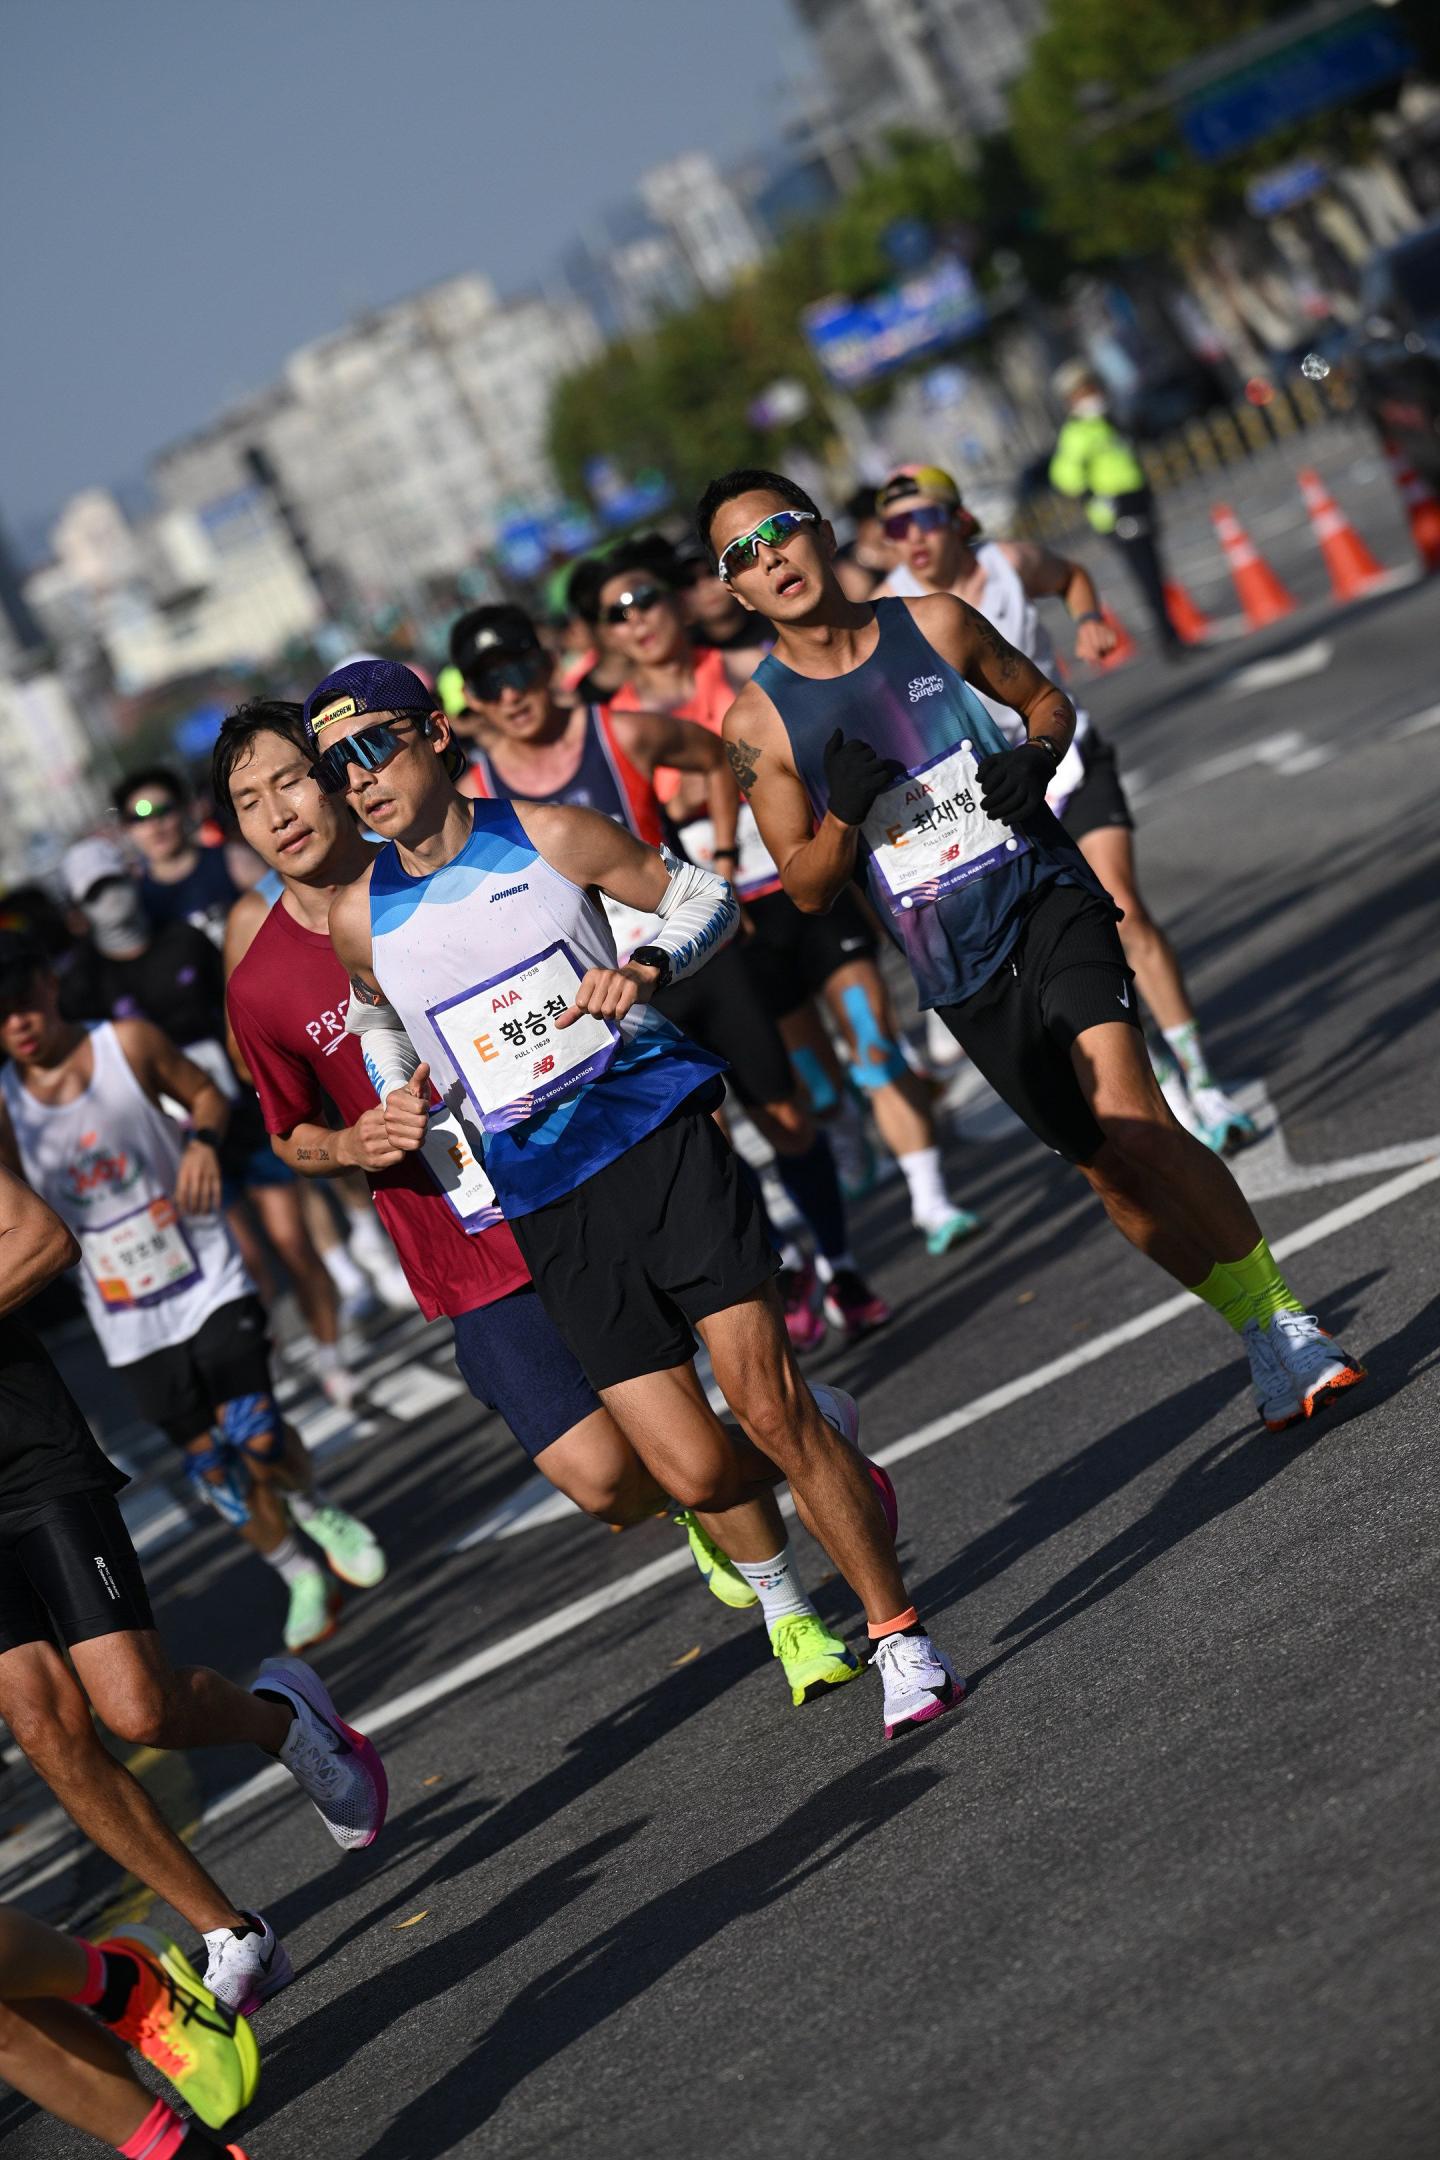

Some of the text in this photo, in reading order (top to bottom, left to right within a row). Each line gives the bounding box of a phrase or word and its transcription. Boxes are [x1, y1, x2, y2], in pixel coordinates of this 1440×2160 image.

[907, 674, 938, 691] Slow
[909, 677, 944, 703] Sunday
[905, 783, 935, 806] AIA
[912, 787, 976, 835] 최재형
[886, 822, 910, 849] E
[489, 883, 529, 904] JOHNBER
[519, 966, 540, 983] 17-038
[491, 989, 523, 1014] AIA
[498, 994, 568, 1047] 황승철
[472, 1033, 500, 1064] E
[514, 1048, 531, 1061] FULL
[546, 1084, 564, 1099] SEOUL
[563, 1066, 594, 1089] MARATHON
